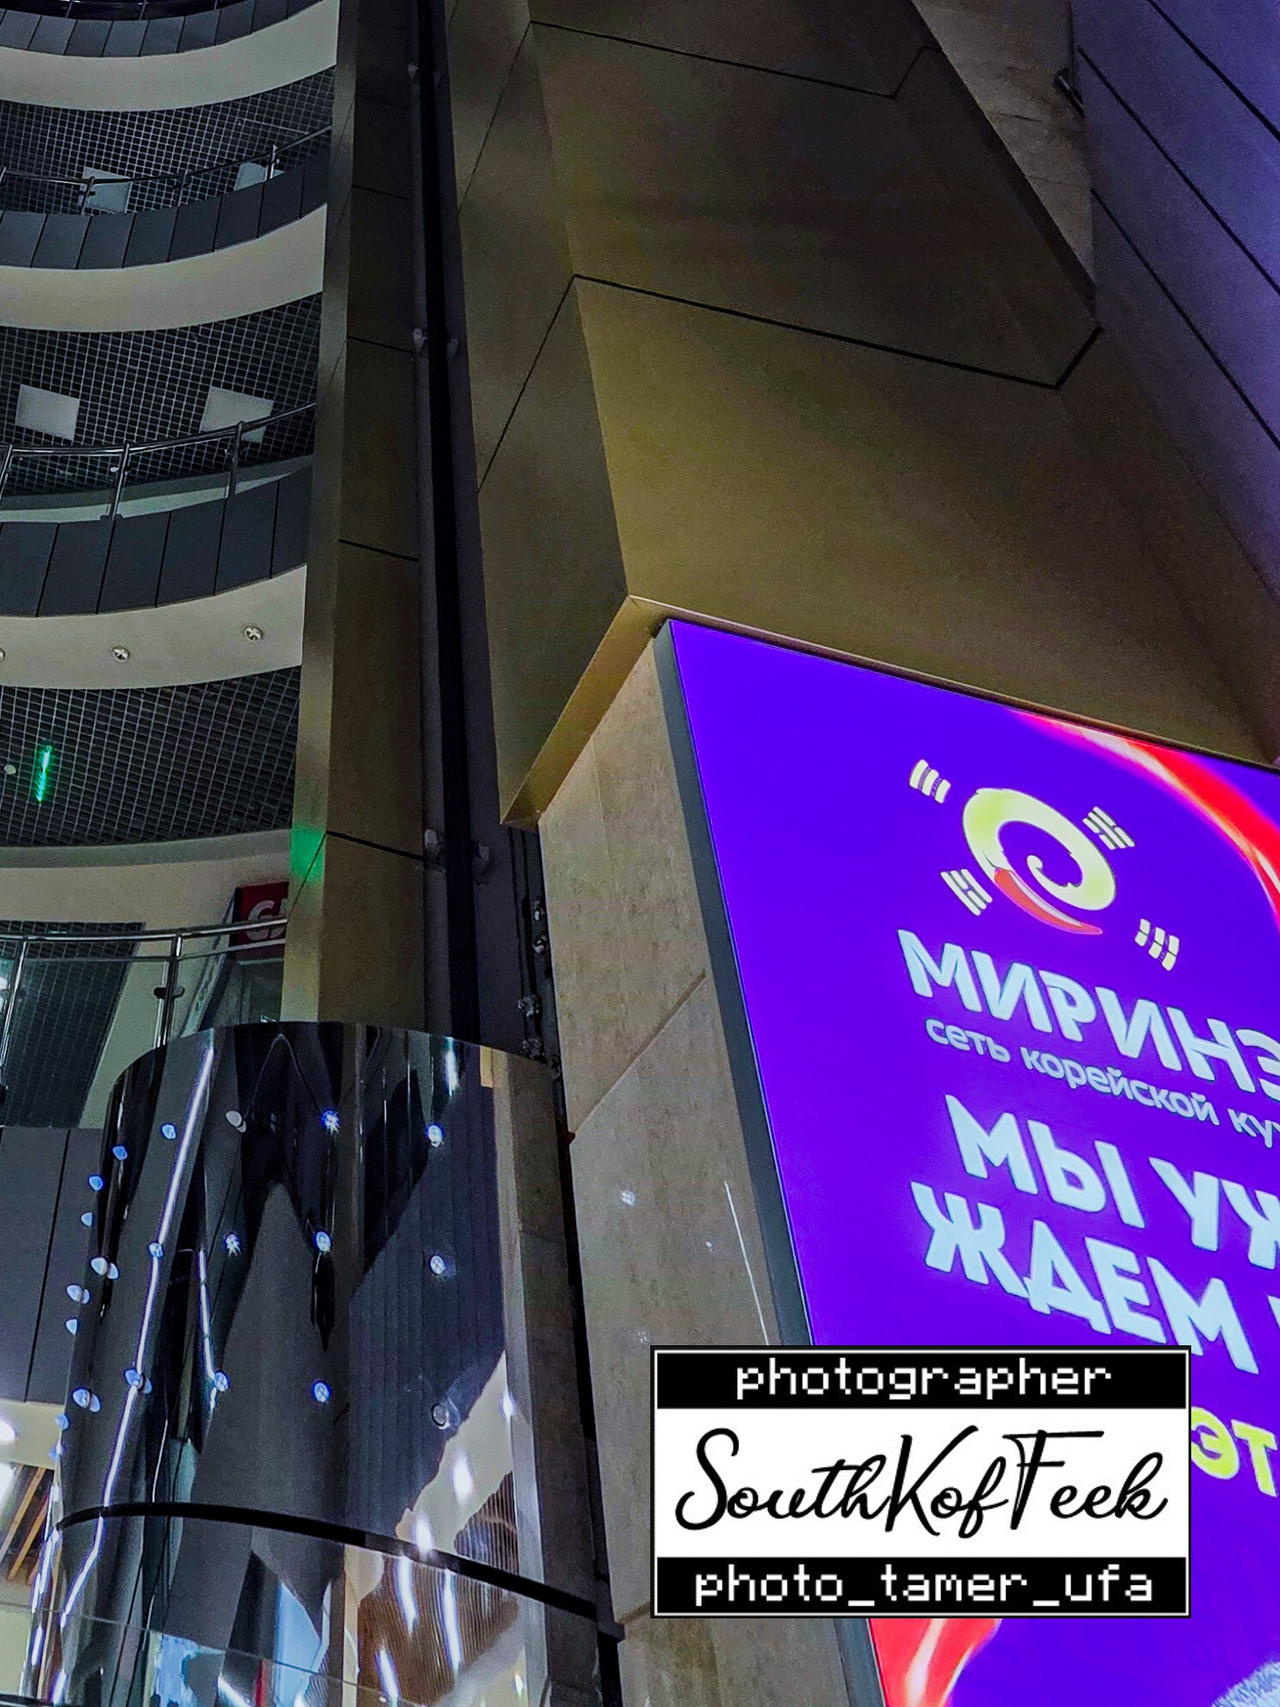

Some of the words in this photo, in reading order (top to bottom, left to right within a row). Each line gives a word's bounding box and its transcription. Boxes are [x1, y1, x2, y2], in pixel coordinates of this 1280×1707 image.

[925, 1018, 1011, 1063] сеть
[1020, 1046, 1220, 1126] корейской
[1227, 1108, 1280, 1148] ку
[945, 1093, 1145, 1229] МЫ
[911, 1180, 1259, 1375] ЖДЕМ
